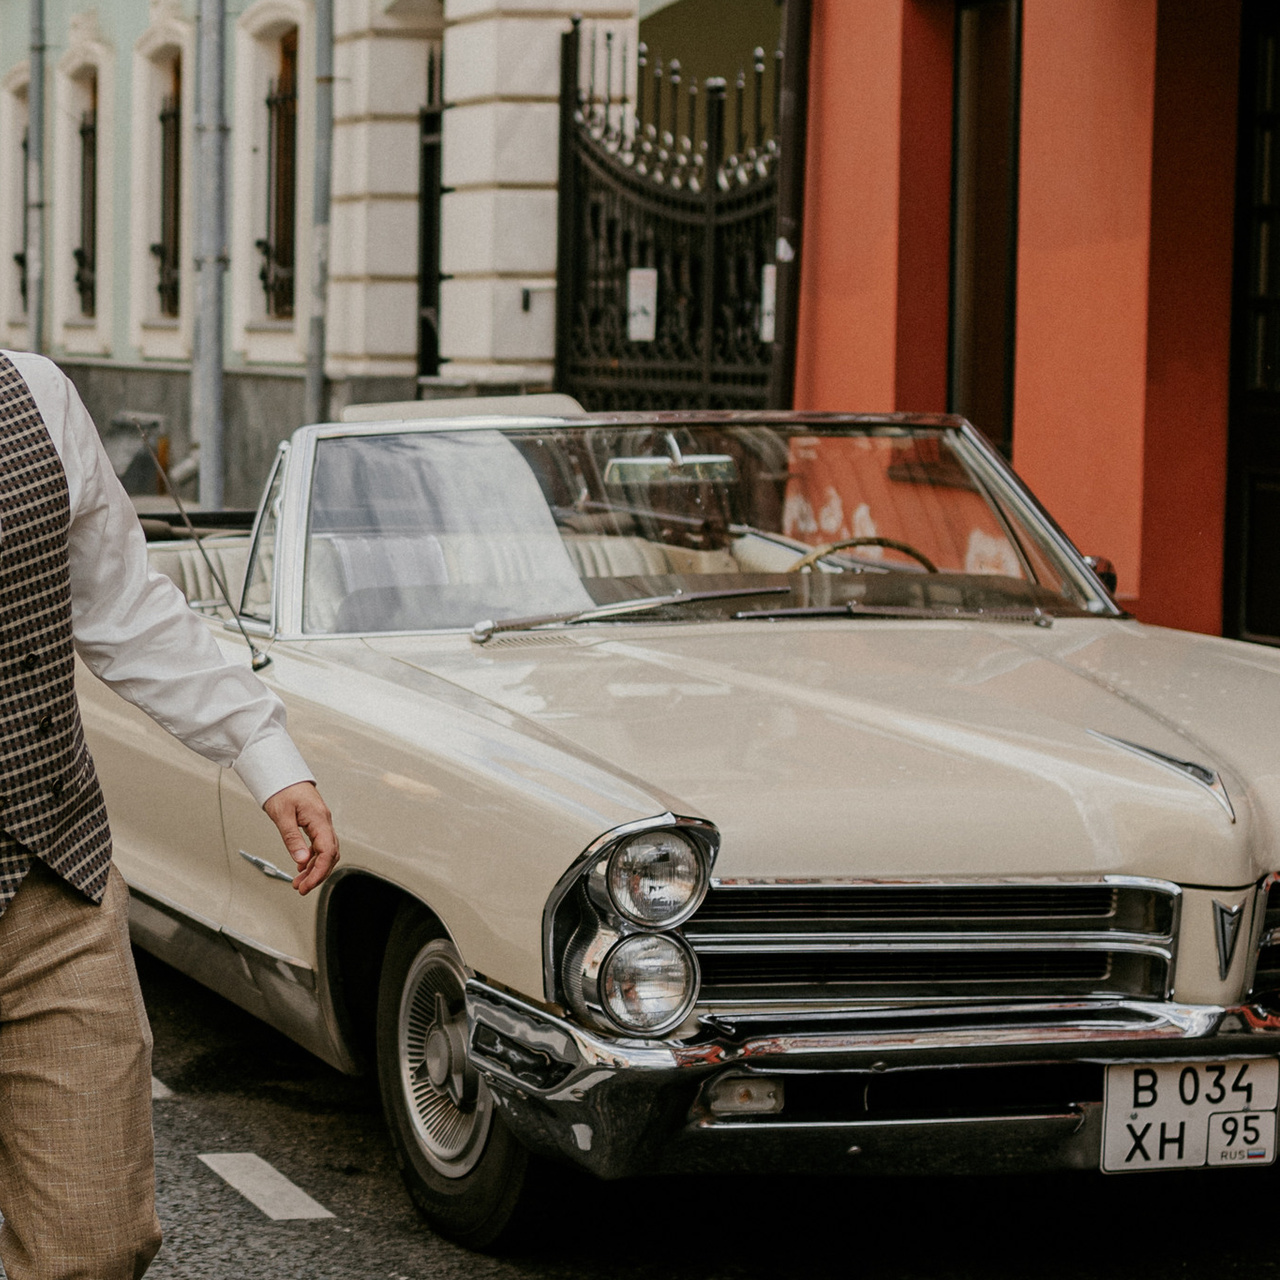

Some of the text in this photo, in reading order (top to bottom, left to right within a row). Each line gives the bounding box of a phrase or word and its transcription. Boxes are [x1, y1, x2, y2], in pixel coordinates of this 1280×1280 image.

[1178, 1063, 1253, 1106] 034
[1221, 1115, 1261, 1147] 95
[1220, 1150, 1246, 1161] RUS
